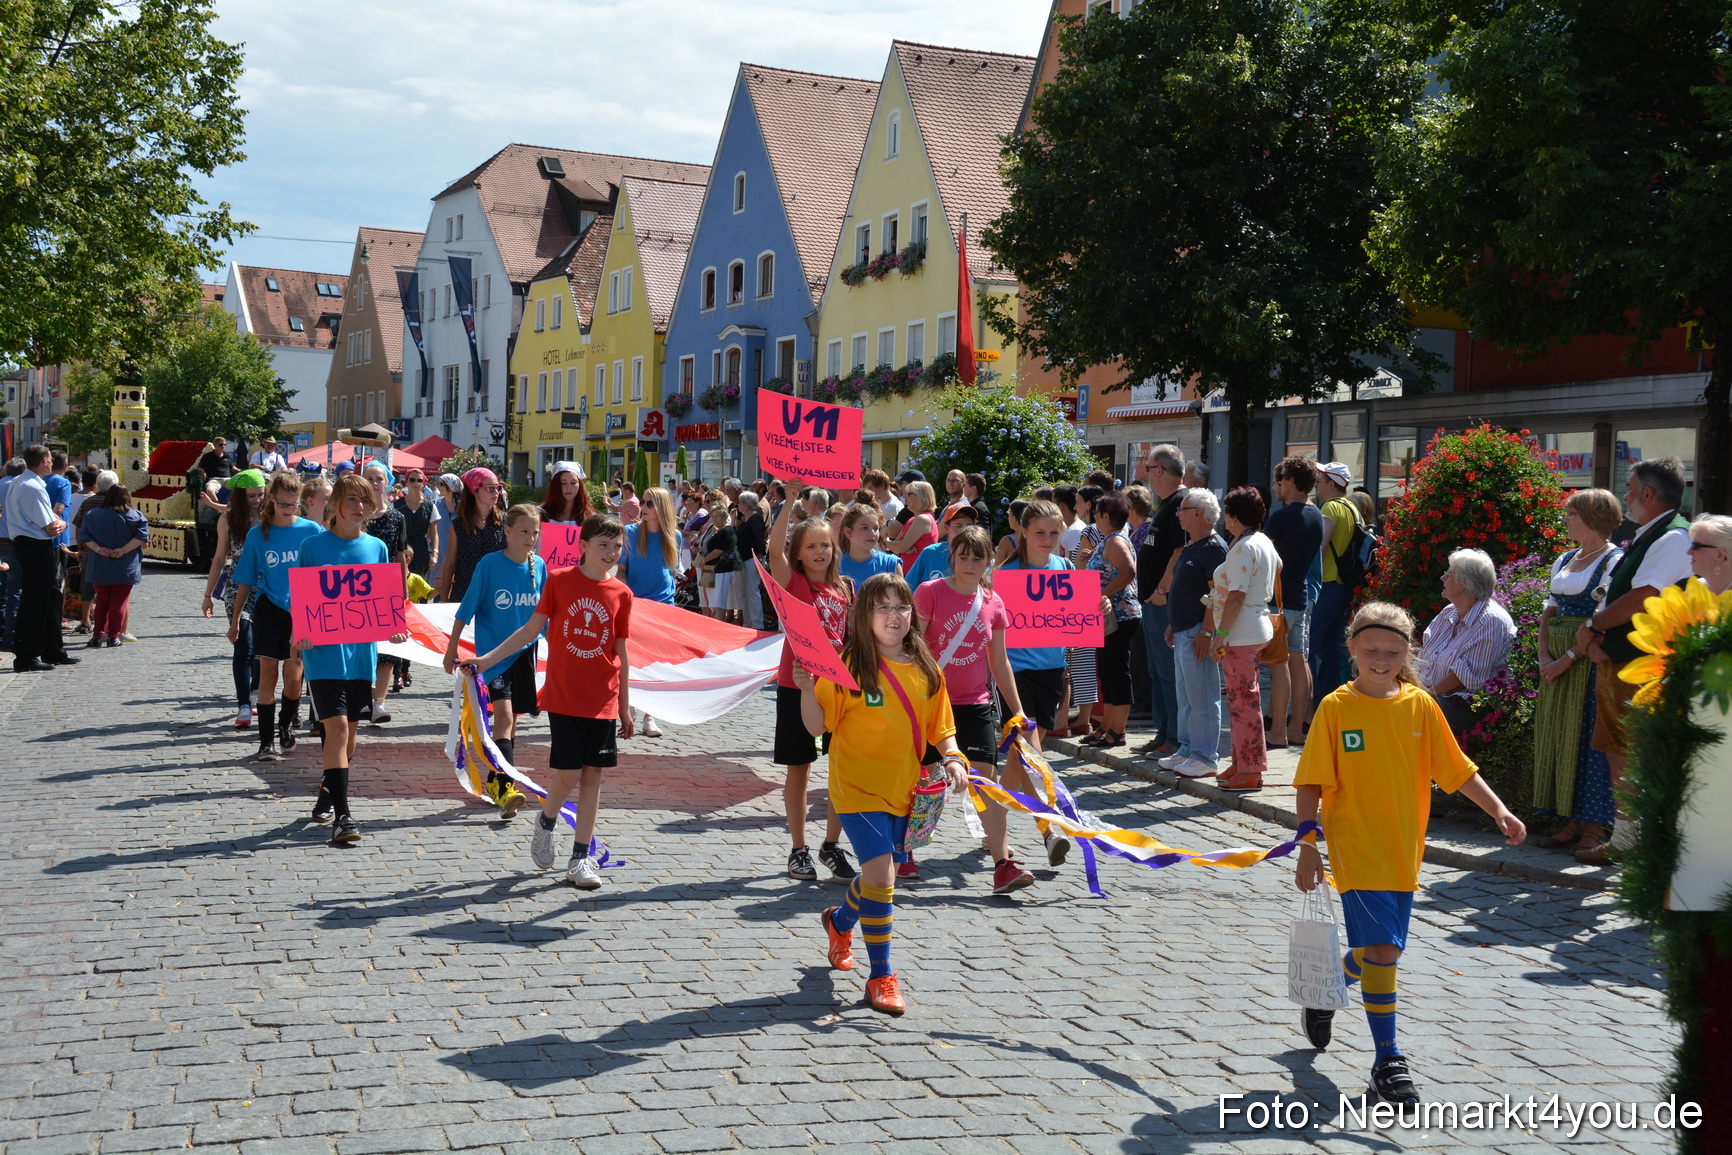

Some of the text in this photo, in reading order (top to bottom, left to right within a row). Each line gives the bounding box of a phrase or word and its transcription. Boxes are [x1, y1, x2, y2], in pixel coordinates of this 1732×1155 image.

[543, 349, 561, 366] HOTEL
[781, 399, 840, 440] U11
[539, 429, 564, 441] Restaurant
[764, 431, 836, 454] VIZEMEISTER
[318, 568, 373, 600] U13
[1026, 573, 1074, 602] U15
[305, 595, 406, 633] MEISTER
[577, 597, 610, 625] POKALSIEGER
[573, 627, 583, 635] SV
[1344, 732, 1361, 749] D
